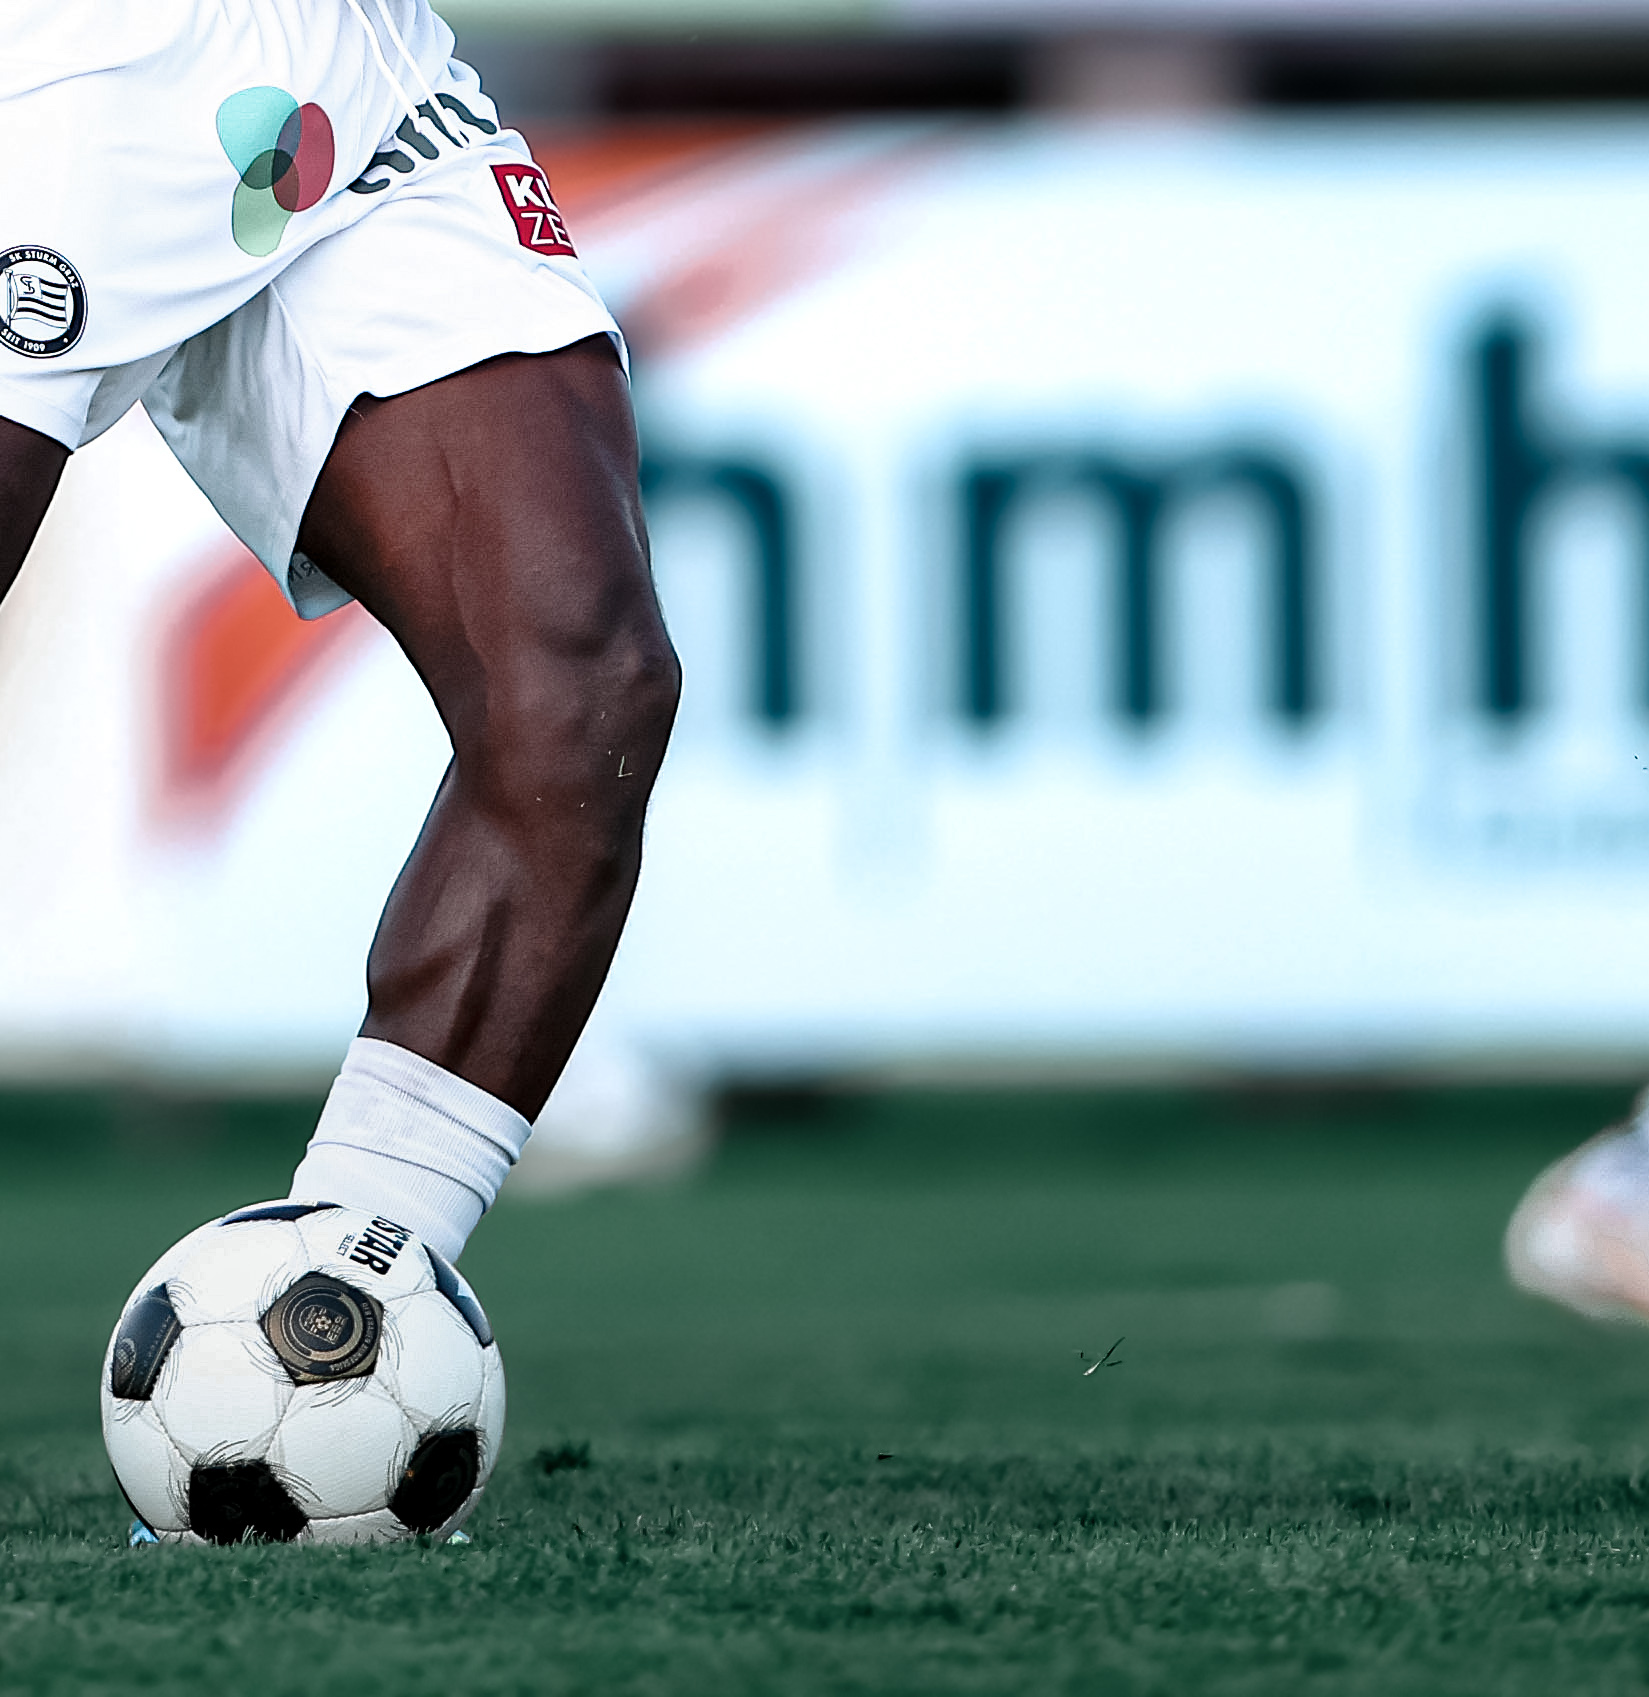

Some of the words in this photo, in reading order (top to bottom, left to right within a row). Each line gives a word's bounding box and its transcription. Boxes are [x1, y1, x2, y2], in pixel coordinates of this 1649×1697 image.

[8, 251, 23, 263] SK
[25, 250, 58, 266] STURM
[58, 264, 80, 289] GRAZ
[0, 328, 21, 345] SEIT
[23, 340, 46, 352] 1909
